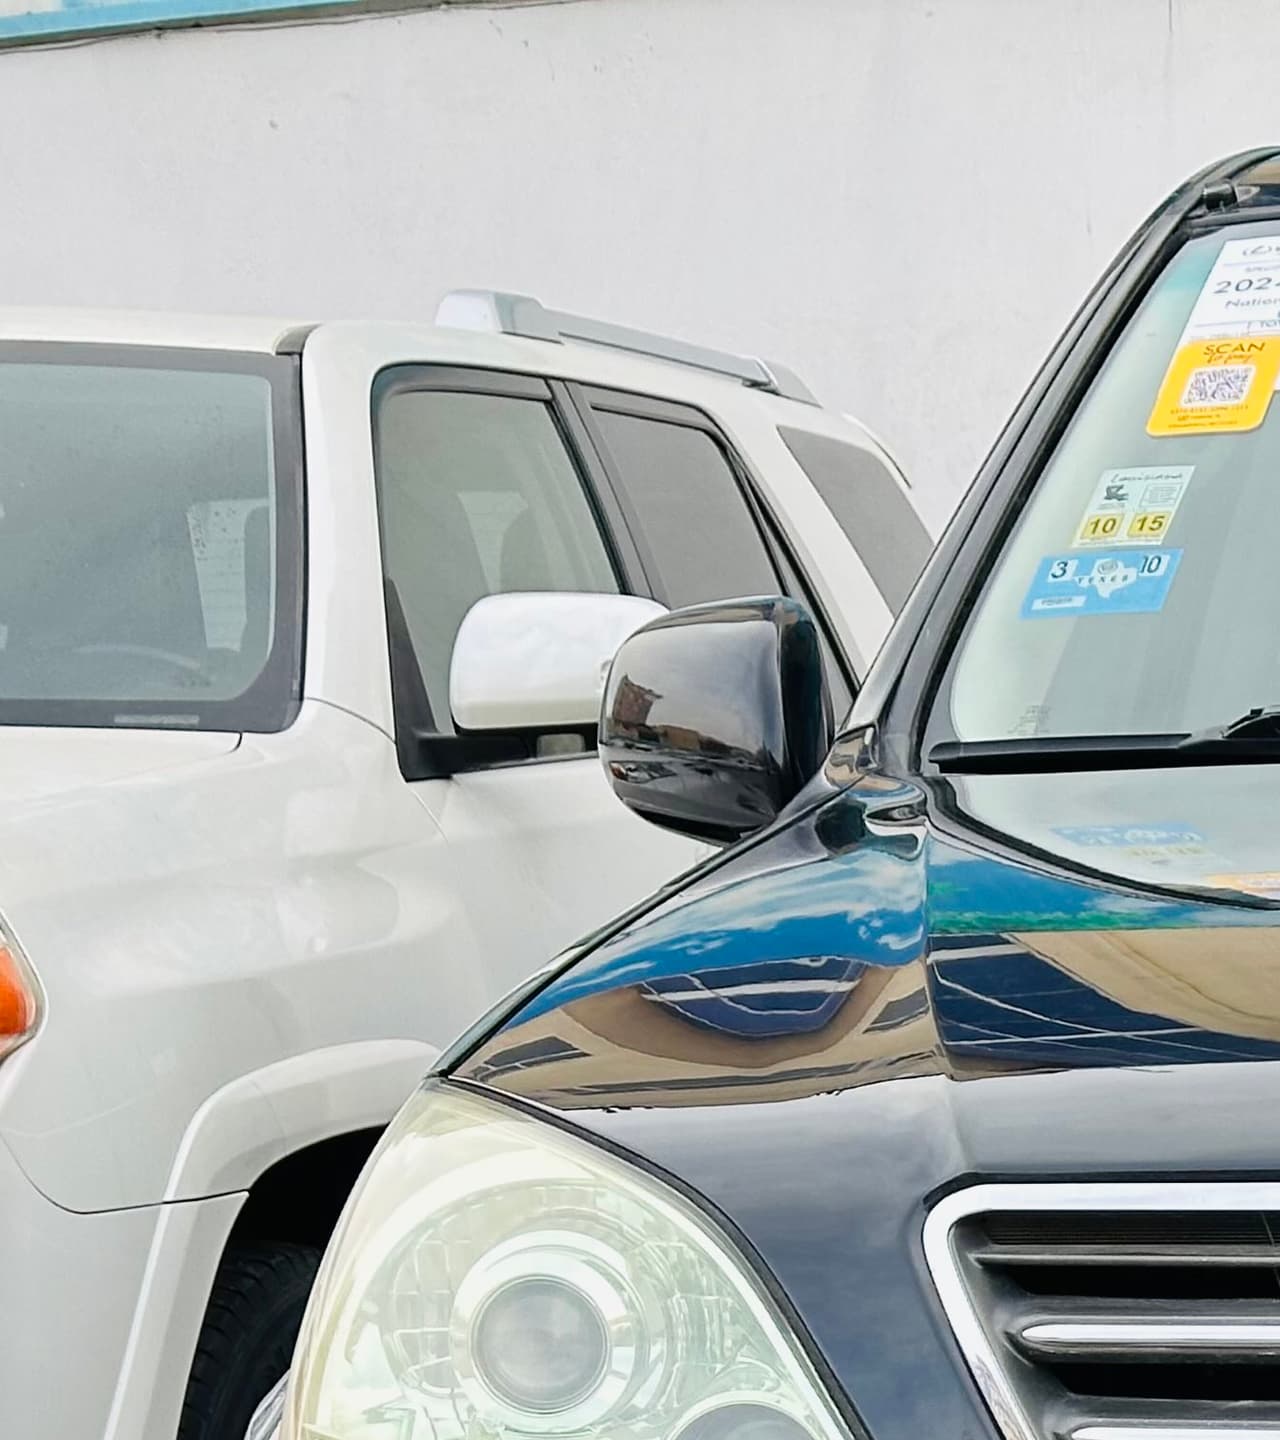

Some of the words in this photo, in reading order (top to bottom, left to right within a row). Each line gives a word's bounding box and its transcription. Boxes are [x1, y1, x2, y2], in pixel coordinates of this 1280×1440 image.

[1203, 341, 1266, 356] SCAN
[1089, 517, 1118, 536] 10
[1136, 514, 1166, 532] 15
[1050, 560, 1068, 580] 3
[1139, 555, 1162, 575] 10
